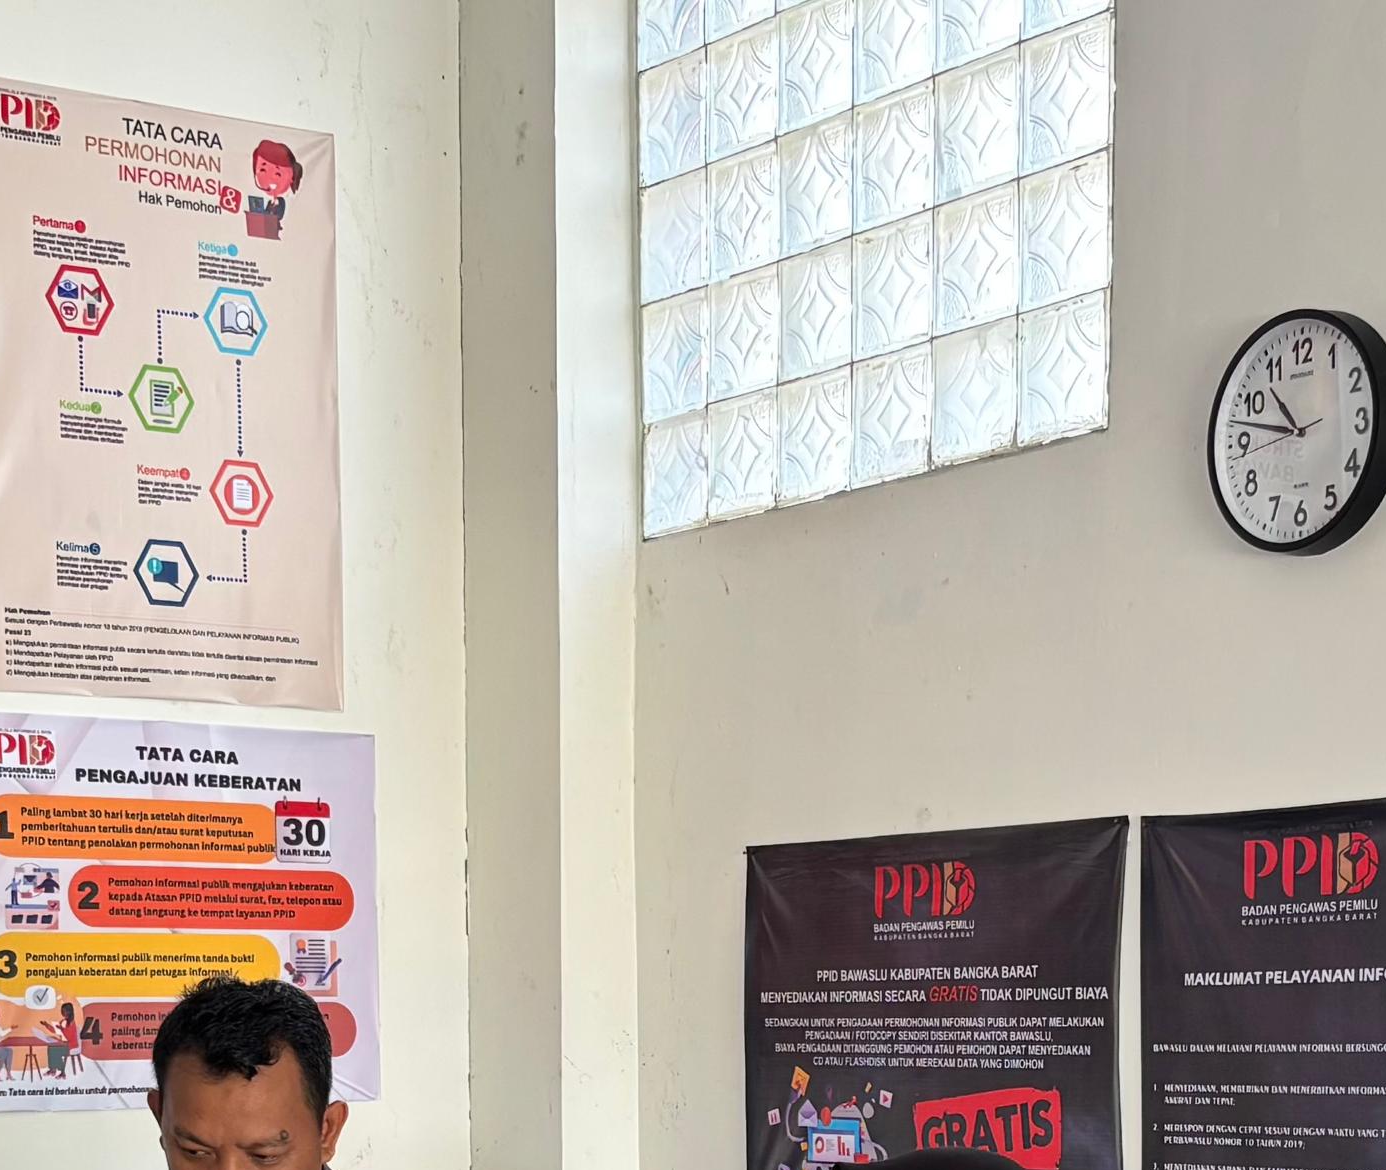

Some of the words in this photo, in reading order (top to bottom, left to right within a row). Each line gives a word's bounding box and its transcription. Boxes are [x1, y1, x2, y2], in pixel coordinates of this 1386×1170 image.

[121, 117, 166, 141] TATA
[170, 125, 222, 150] CARA
[84, 135, 220, 173] PERMOHONAN
[118, 164, 222, 197] INFORMASI
[138, 189, 162, 205] Hak
[165, 194, 222, 214] Pemohon
[34, 215, 74, 230] Pertama
[198, 241, 227, 256] Ketiga
[1292, 337, 1313, 365] 12
[1327, 343, 1336, 369] 1
[1266, 356, 1282, 383] 11
[1349, 367, 1361, 393] 2
[1243, 391, 1264, 417] 10
[1354, 407, 1369, 435] 3
[1237, 432, 1251, 458] 9
[137, 466, 181, 480] Keempat
[1344, 448, 1361, 478] 4
[1244, 469, 1258, 497] 8
[1269, 495, 1281, 521] 7
[1323, 484, 1337, 510] 5
[1294, 500, 1307, 527] 6
[56, 540, 90, 556] Kelima
[135, 745, 184, 761] TATA
[189, 748, 238, 764] CARA
[75, 767, 188, 786] PENGAJUAN
[194, 773, 300, 791] KEBERATAN
[282, 817, 325, 846] 30
[279, 848, 300, 856] HARI
[302, 849, 331, 857] KERJA
[1243, 832, 1380, 900] PPID
[77, 880, 99, 909] 2
[874, 860, 976, 918] PPID
[816, 969, 838, 981] PPID
[840, 968, 887, 981] BAWASLU
[890, 967, 950, 980] KABUPATEN
[953, 966, 999, 979] BANGKA
[1001, 964, 1038, 978] BARAT
[1184, 971, 1262, 985] MAKLUMAT
[1265, 968, 1354, 984] PELAYANAN
[760, 991, 827, 1003] MENYEDIAKAN
[829, 990, 882, 1002] INFORMASI
[884, 989, 926, 1002] SECARA
[929, 984, 978, 1002] GRATIS
[981, 988, 1012, 1001] TIDAK
[1015, 986, 1072, 1000] DIPUNGUT
[1075, 986, 1108, 999] BIAYA
[79, 1016, 103, 1045] 4
[922, 1099, 1054, 1151] GRATIS
